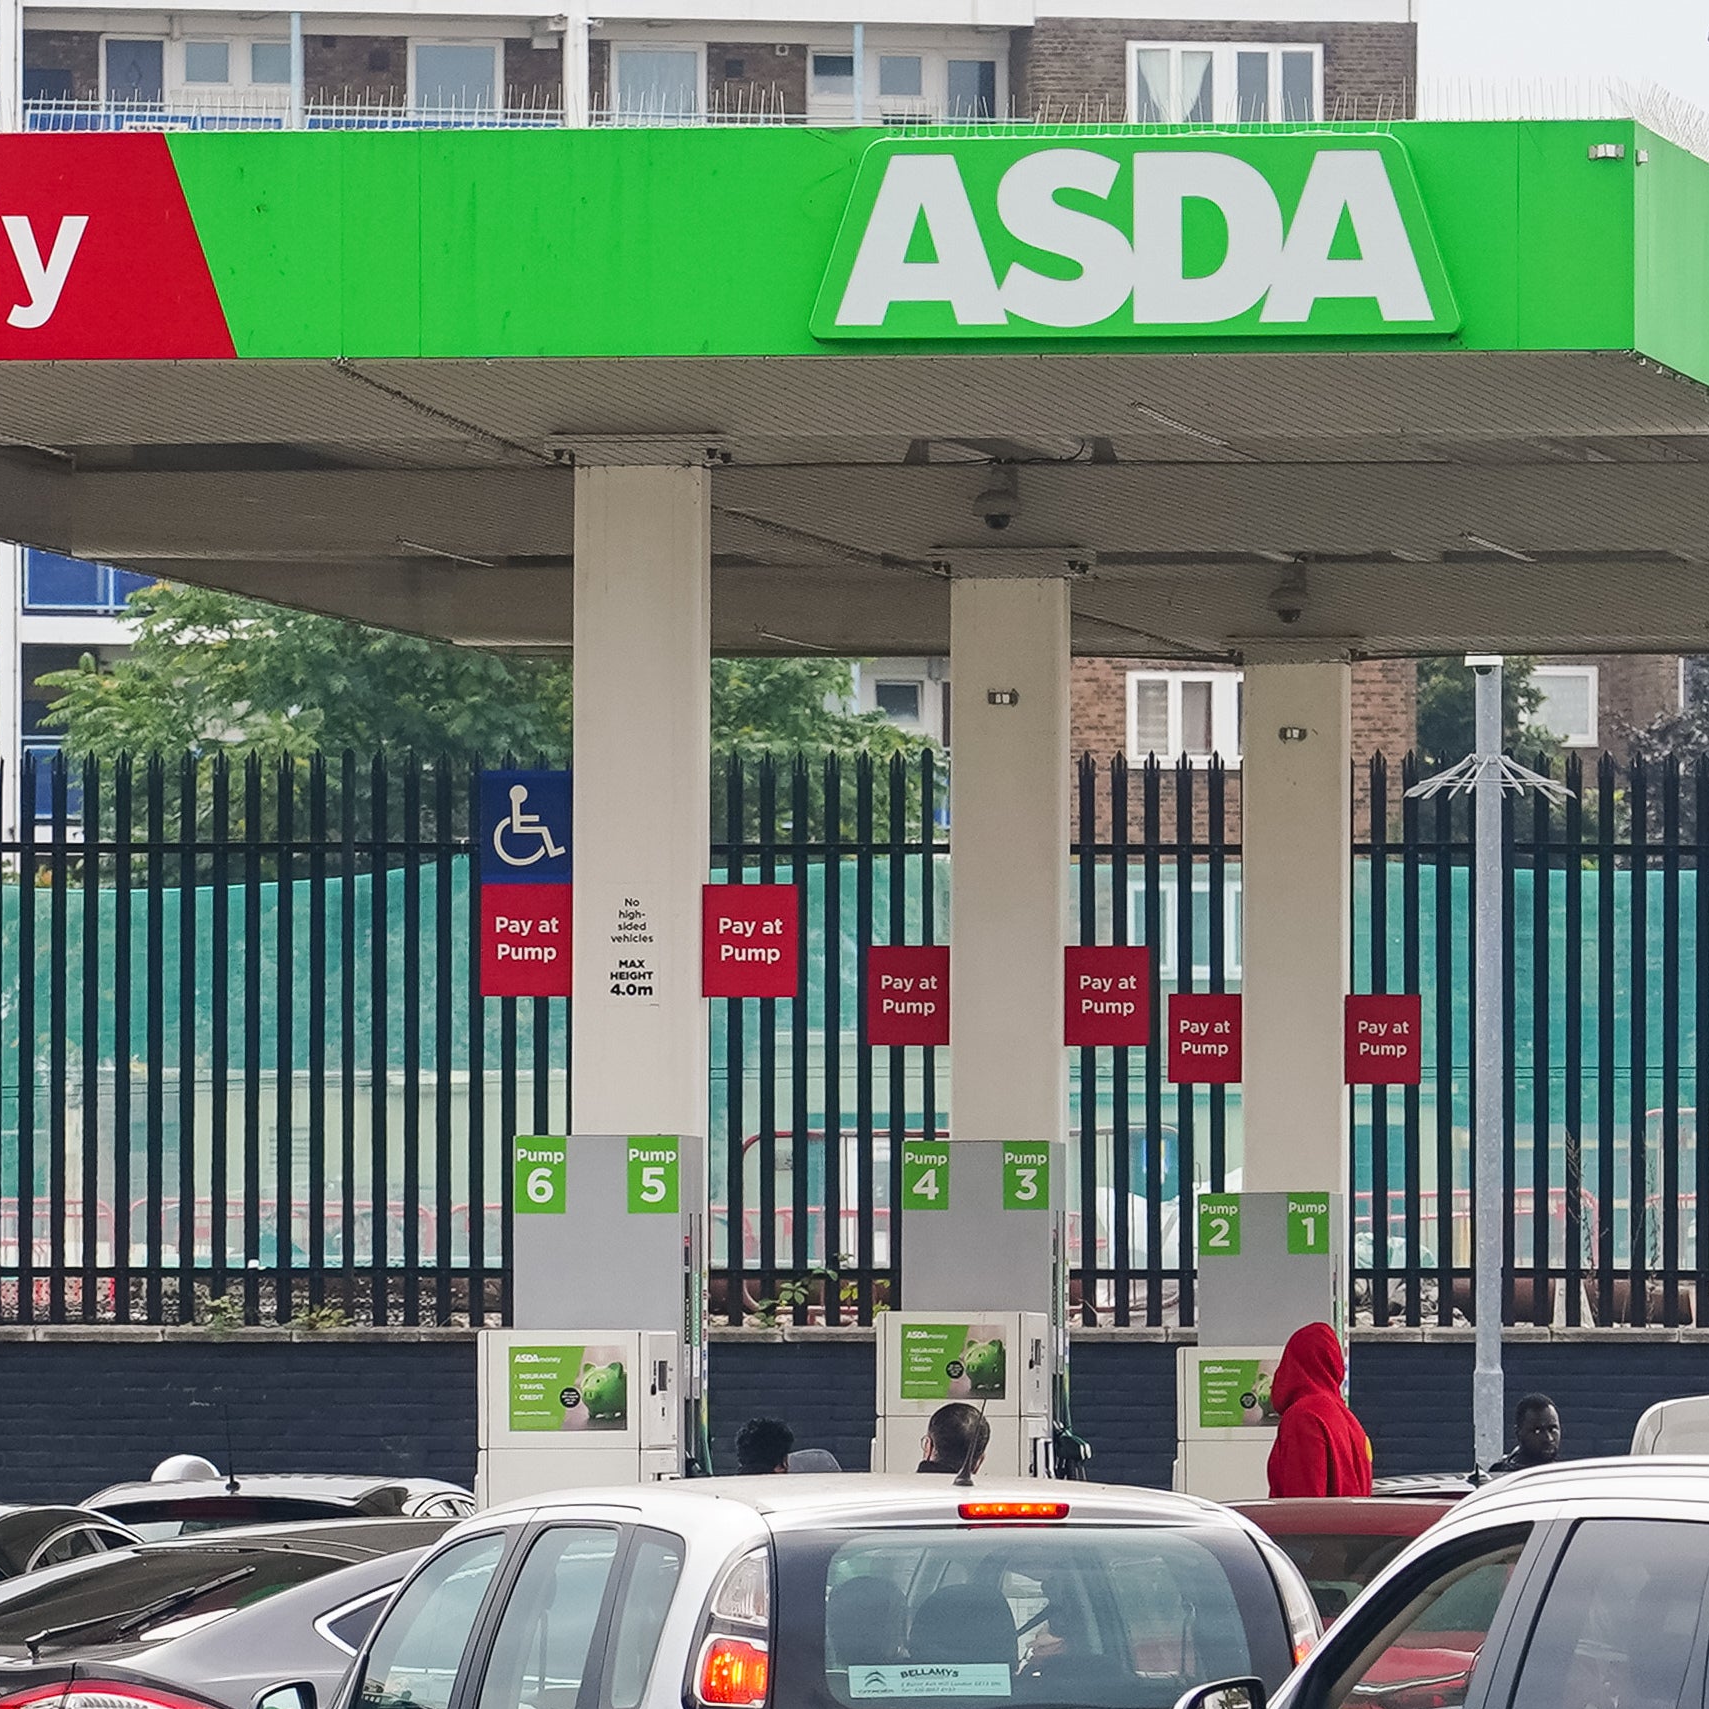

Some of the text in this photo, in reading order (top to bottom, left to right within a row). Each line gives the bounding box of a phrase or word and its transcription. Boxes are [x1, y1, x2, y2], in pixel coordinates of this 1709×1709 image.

[834, 148, 1436, 327] ASDA
[624, 898, 640, 907] No
[618, 910, 646, 920] high-
[495, 916, 559, 937] Pay at
[617, 922, 647, 931] sided
[718, 917, 783, 937] Pay at
[610, 934, 654, 943] vehicles
[497, 944, 557, 963] Pump
[720, 945, 781, 964] Pump
[618, 960, 646, 968] MAX
[610, 971, 653, 980] HEIGHT
[881, 975, 938, 992] Pay at
[1079, 975, 1137, 992] Pay at
[610, 983, 653, 996] 4.0m
[882, 999, 936, 1016] Pump
[1081, 999, 1135, 1017] Pump
[1179, 1020, 1231, 1036] Pay at
[1358, 1020, 1409, 1036] Pay at
[1181, 1042, 1229, 1057] Pump
[1359, 1042, 1407, 1058] Pump
[516, 1148, 565, 1164] Pump
[629, 1148, 677, 1163] Pump
[905, 1152, 947, 1166] Pump
[1005, 1152, 1047, 1166] Pump
[527, 1168, 554, 1203] 6
[640, 1167, 666, 1203] 5
[912, 1169, 939, 1200] 4
[1014, 1169, 1038, 1200] 3
[1199, 1203, 1238, 1216] Pump
[1288, 1202, 1327, 1214] Pump
[1209, 1218, 1230, 1247] 2
[1301, 1217, 1315, 1246] 1
